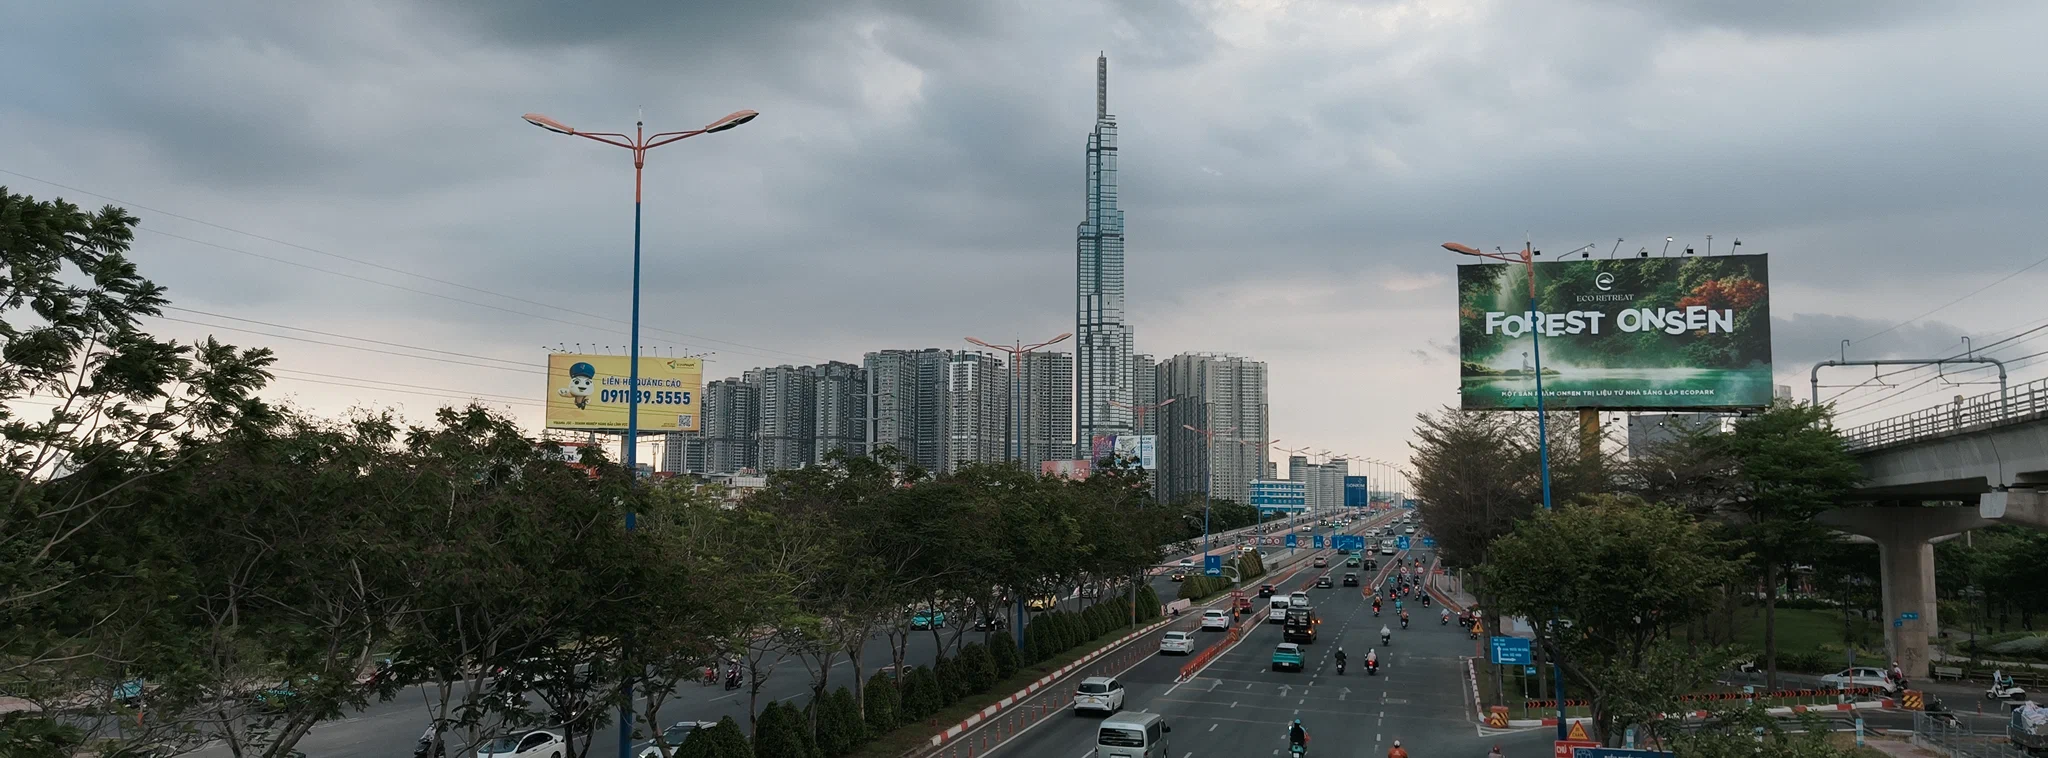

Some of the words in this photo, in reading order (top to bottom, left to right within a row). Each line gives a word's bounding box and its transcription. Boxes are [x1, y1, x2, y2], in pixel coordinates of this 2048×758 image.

[1576, 294, 1595, 302] ECO
[1595, 293, 1635, 302] RETREAT
[1485, 310, 1605, 338] FOREST
[1616, 306, 1734, 335] ONSEN
[601, 376, 620, 385] LIÊN
[665, 378, 681, 388] CÁO
[1595, 388, 1612, 397] LIỆU
[1613, 388, 1625, 396] TỪ
[1625, 388, 1641, 396] NHÀ
[1642, 388, 1663, 396] SÁNG
[1664, 388, 1679, 397] LẬP
[1556, 744, 1567, 754] CHÚ
